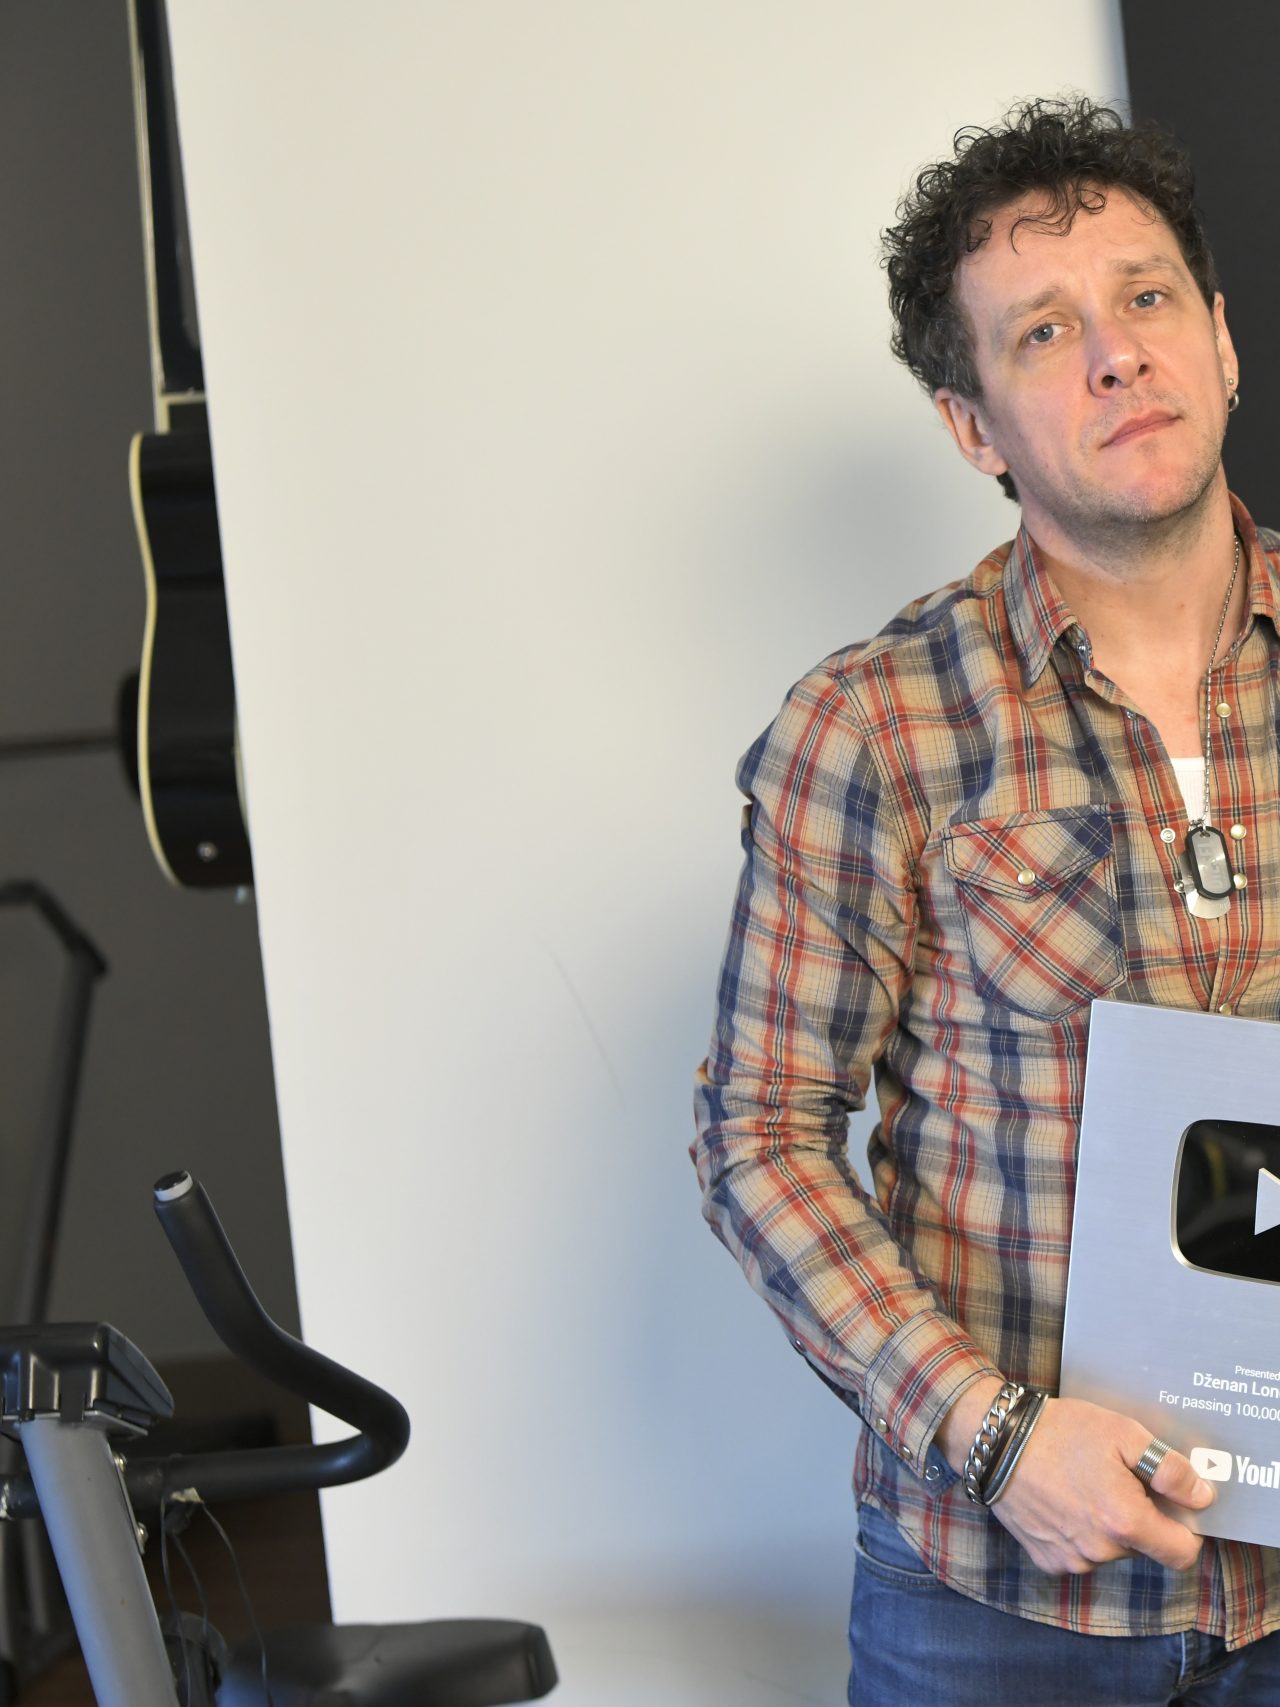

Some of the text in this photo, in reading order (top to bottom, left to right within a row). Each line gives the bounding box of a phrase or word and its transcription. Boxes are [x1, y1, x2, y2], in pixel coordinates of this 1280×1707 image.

[1192, 1372, 1248, 1394] Dženan
[1235, 1365, 1280, 1381] Presented
[1159, 1390, 1180, 1405] For
[1182, 1398, 1232, 1416] passing
